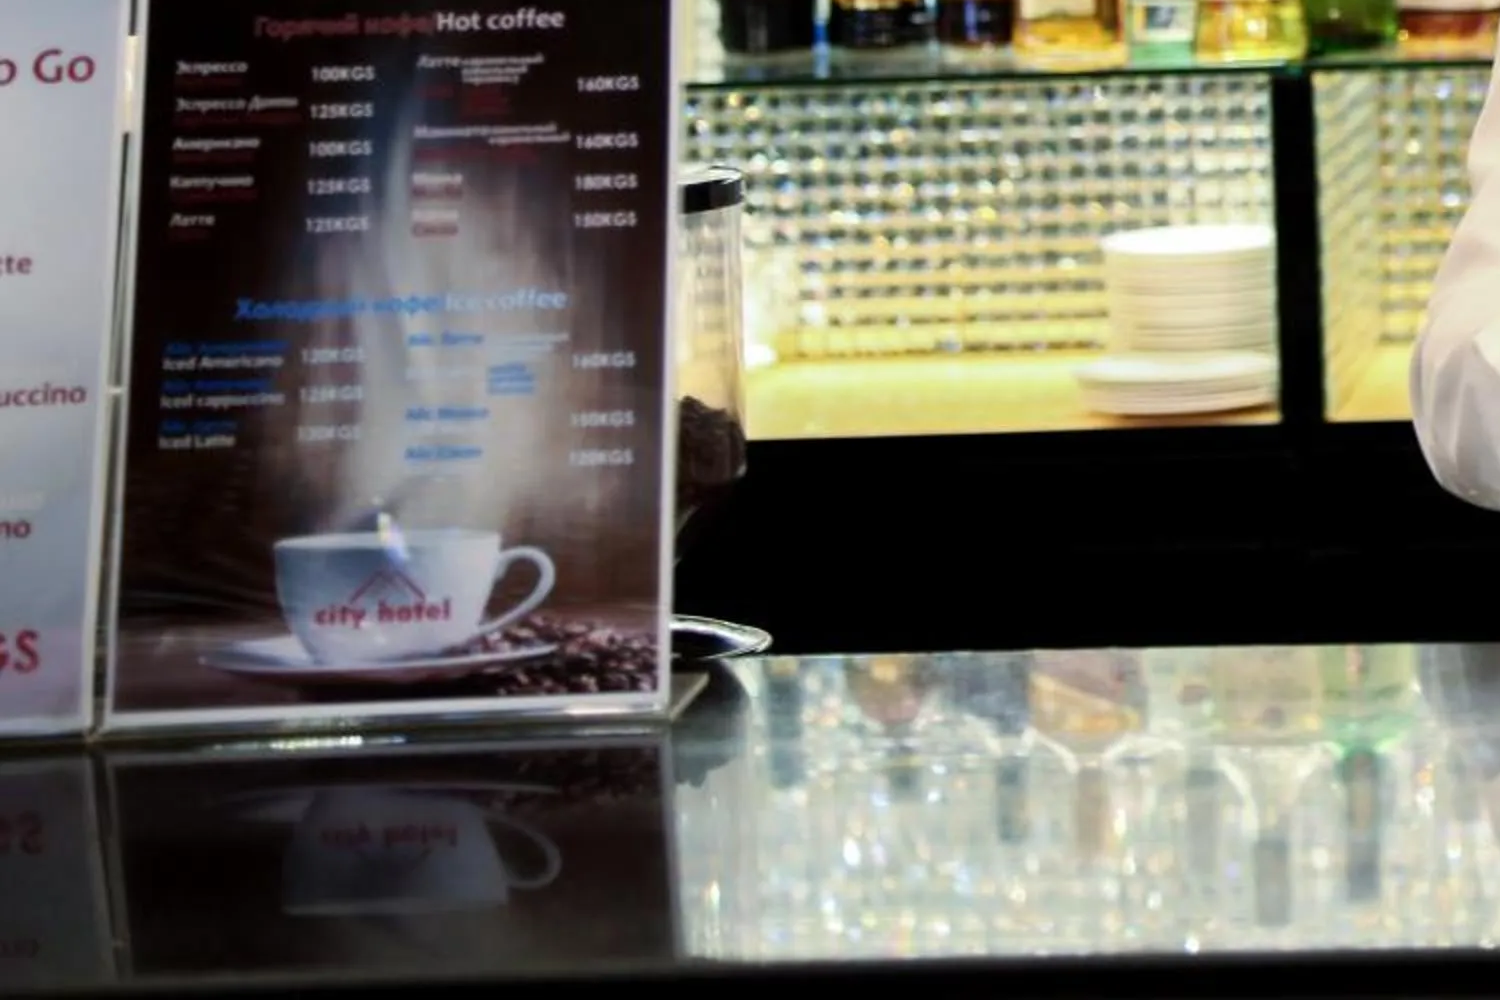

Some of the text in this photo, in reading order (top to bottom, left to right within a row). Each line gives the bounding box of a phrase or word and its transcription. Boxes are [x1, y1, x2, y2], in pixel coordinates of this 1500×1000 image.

[437, 10, 481, 32] Hot
[486, 6, 566, 31] coffee
[33, 48, 95, 84] Go
[311, 66, 376, 82] 100KGS
[577, 75, 640, 92] 160KGS
[315, 599, 451, 629] city hotel
